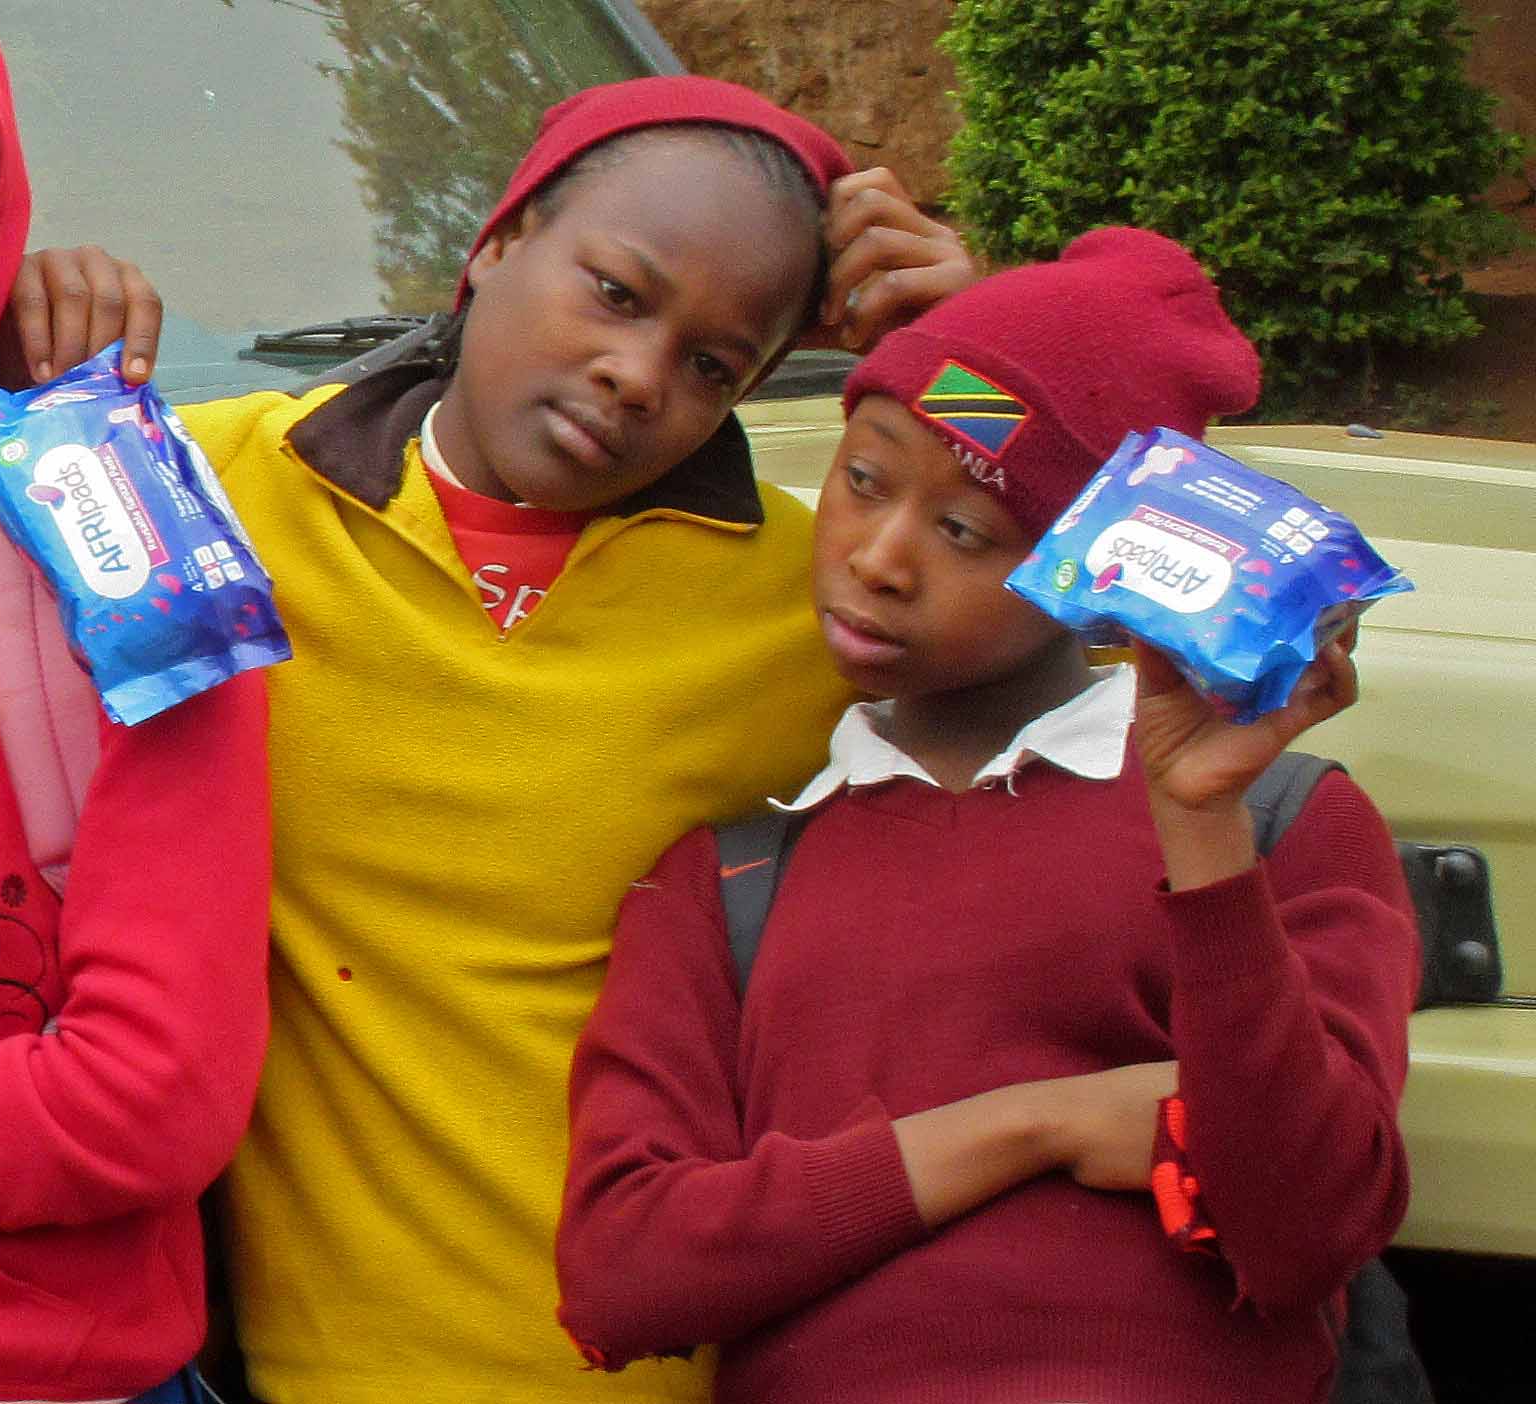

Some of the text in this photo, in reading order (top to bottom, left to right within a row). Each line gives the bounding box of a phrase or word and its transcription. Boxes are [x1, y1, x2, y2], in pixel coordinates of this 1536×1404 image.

[55, 462, 130, 573] AFRIpads
[472, 564, 549, 630] Sp
[1107, 537, 1211, 595] AFRIpads
